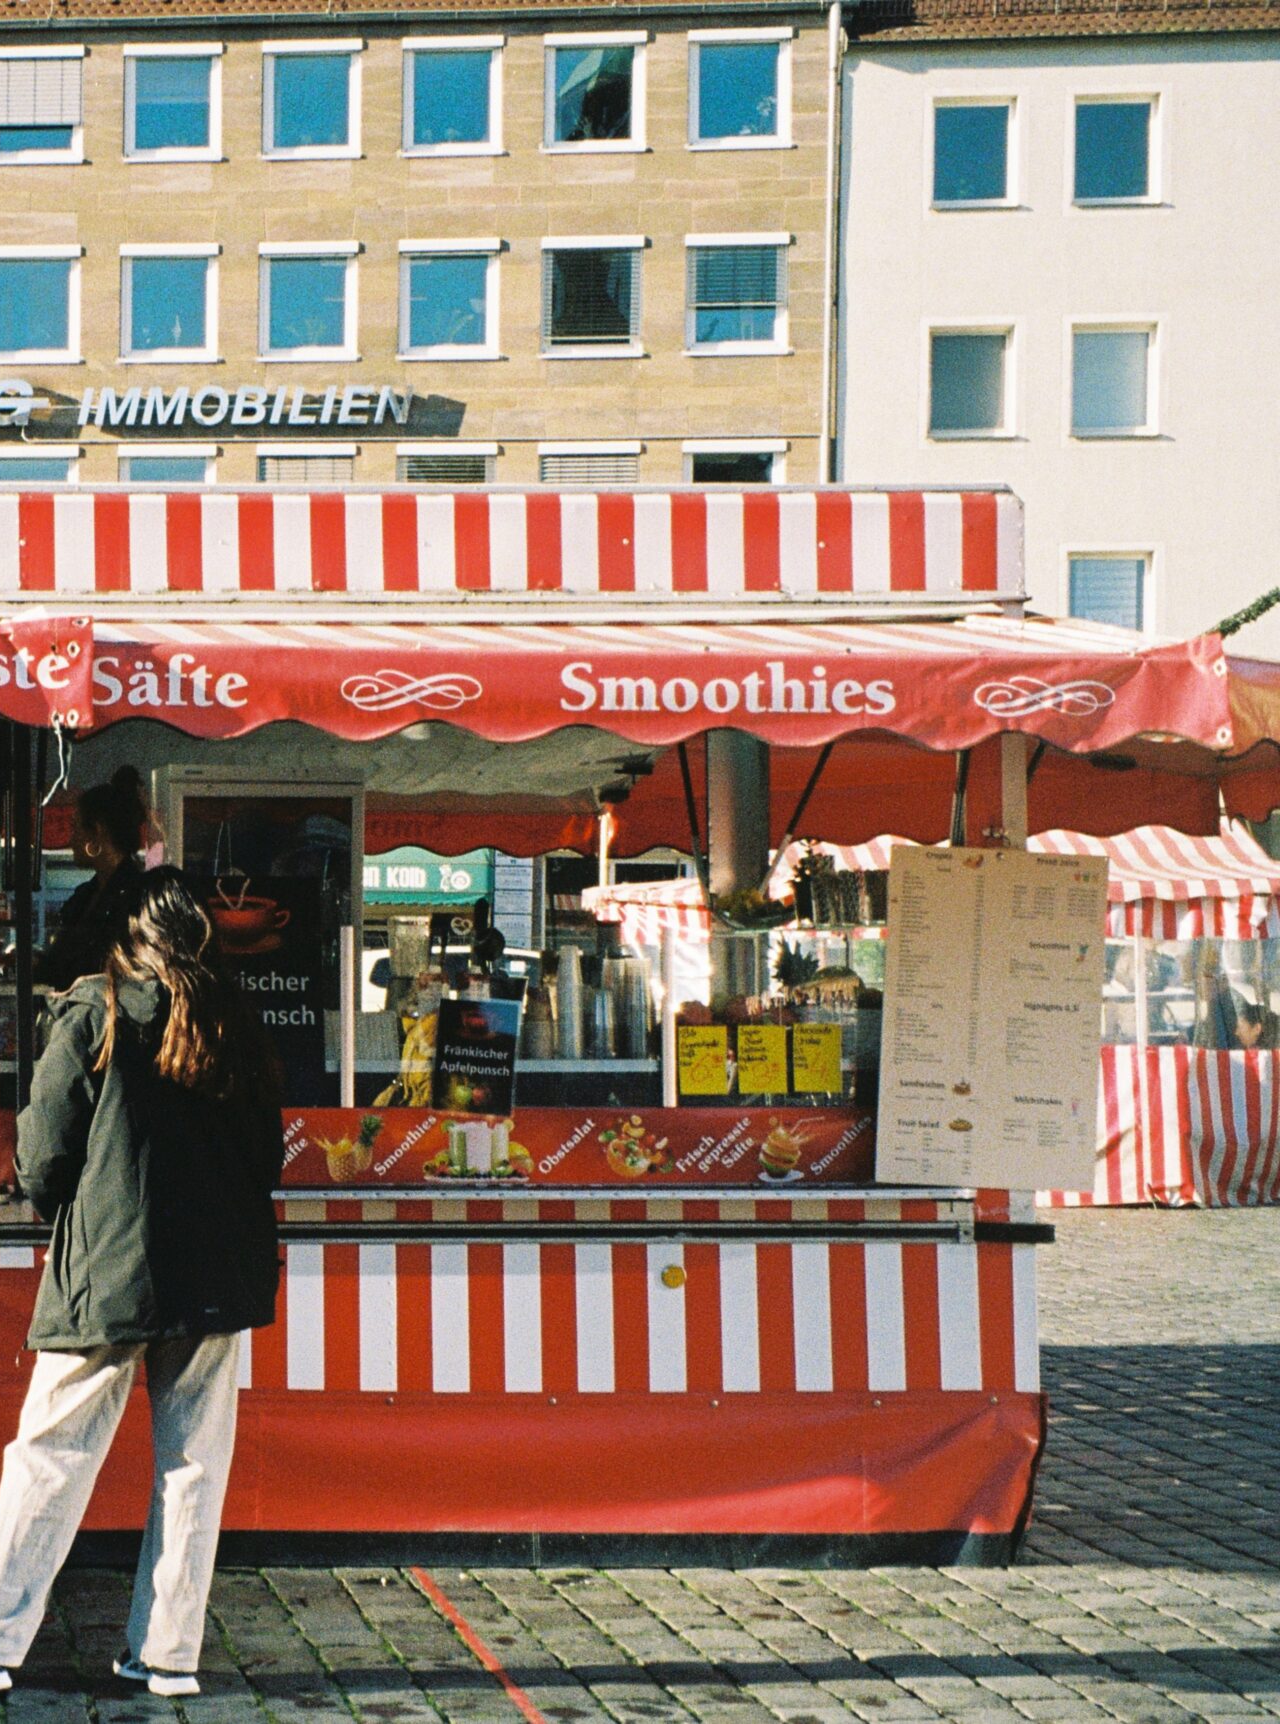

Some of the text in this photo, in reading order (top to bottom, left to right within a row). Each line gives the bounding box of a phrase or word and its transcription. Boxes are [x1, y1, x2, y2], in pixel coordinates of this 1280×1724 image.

[77, 384, 414, 427] IMMOBILIEN
[91, 653, 249, 706] Säfte
[559, 660, 896, 715] Smoothies
[233, 970, 310, 992] ischer
[440, 1060, 511, 1078] Apfelpunsch
[443, 1043, 509, 1062] Fränkischer
[899, 1079, 945, 1089] Sandwiches
[897, 1118, 940, 1129] Fruit Salad
[373, 1114, 438, 1176] Smoothies
[537, 1117, 597, 1175] Obstsalat
[675, 1134, 716, 1174] Frisch
[697, 1115, 753, 1174] gepresste
[721, 1134, 757, 1169] Säfte
[810, 1115, 873, 1177] Smoothies
